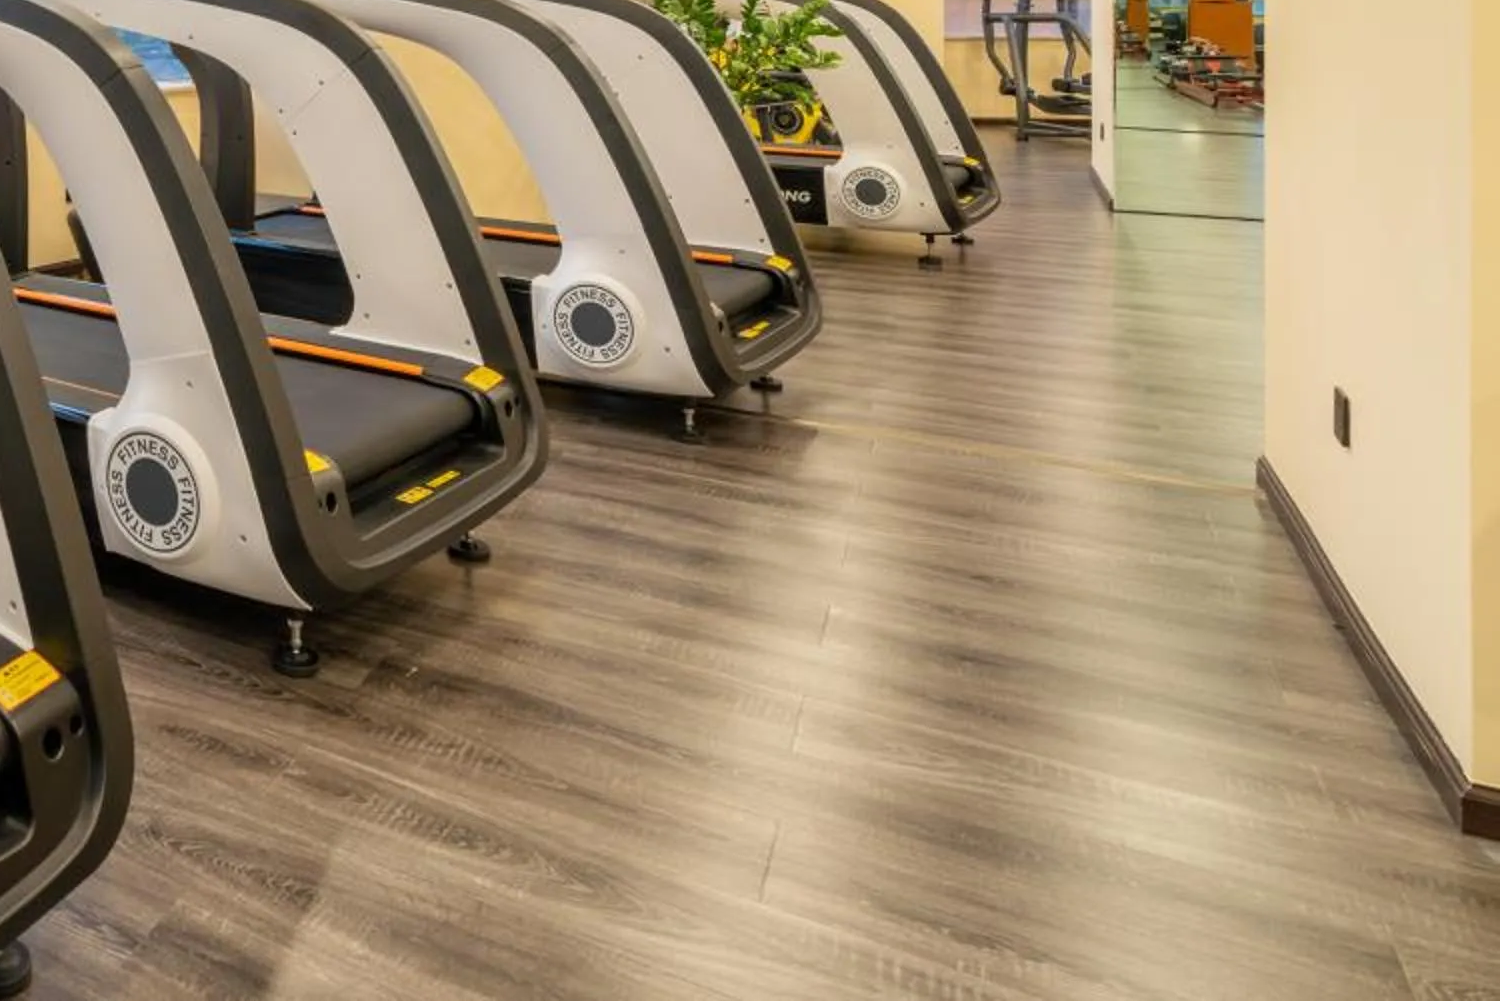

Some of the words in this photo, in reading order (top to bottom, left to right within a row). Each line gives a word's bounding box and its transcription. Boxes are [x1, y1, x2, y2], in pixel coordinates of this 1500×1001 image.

[563, 288, 617, 309] FITNESS
[558, 312, 595, 358] FITNESS
[600, 312, 629, 359] FITNESS
[117, 438, 180, 470] FITNESS
[111, 470, 153, 543] FITNESS
[161, 476, 195, 546] FITNESS
